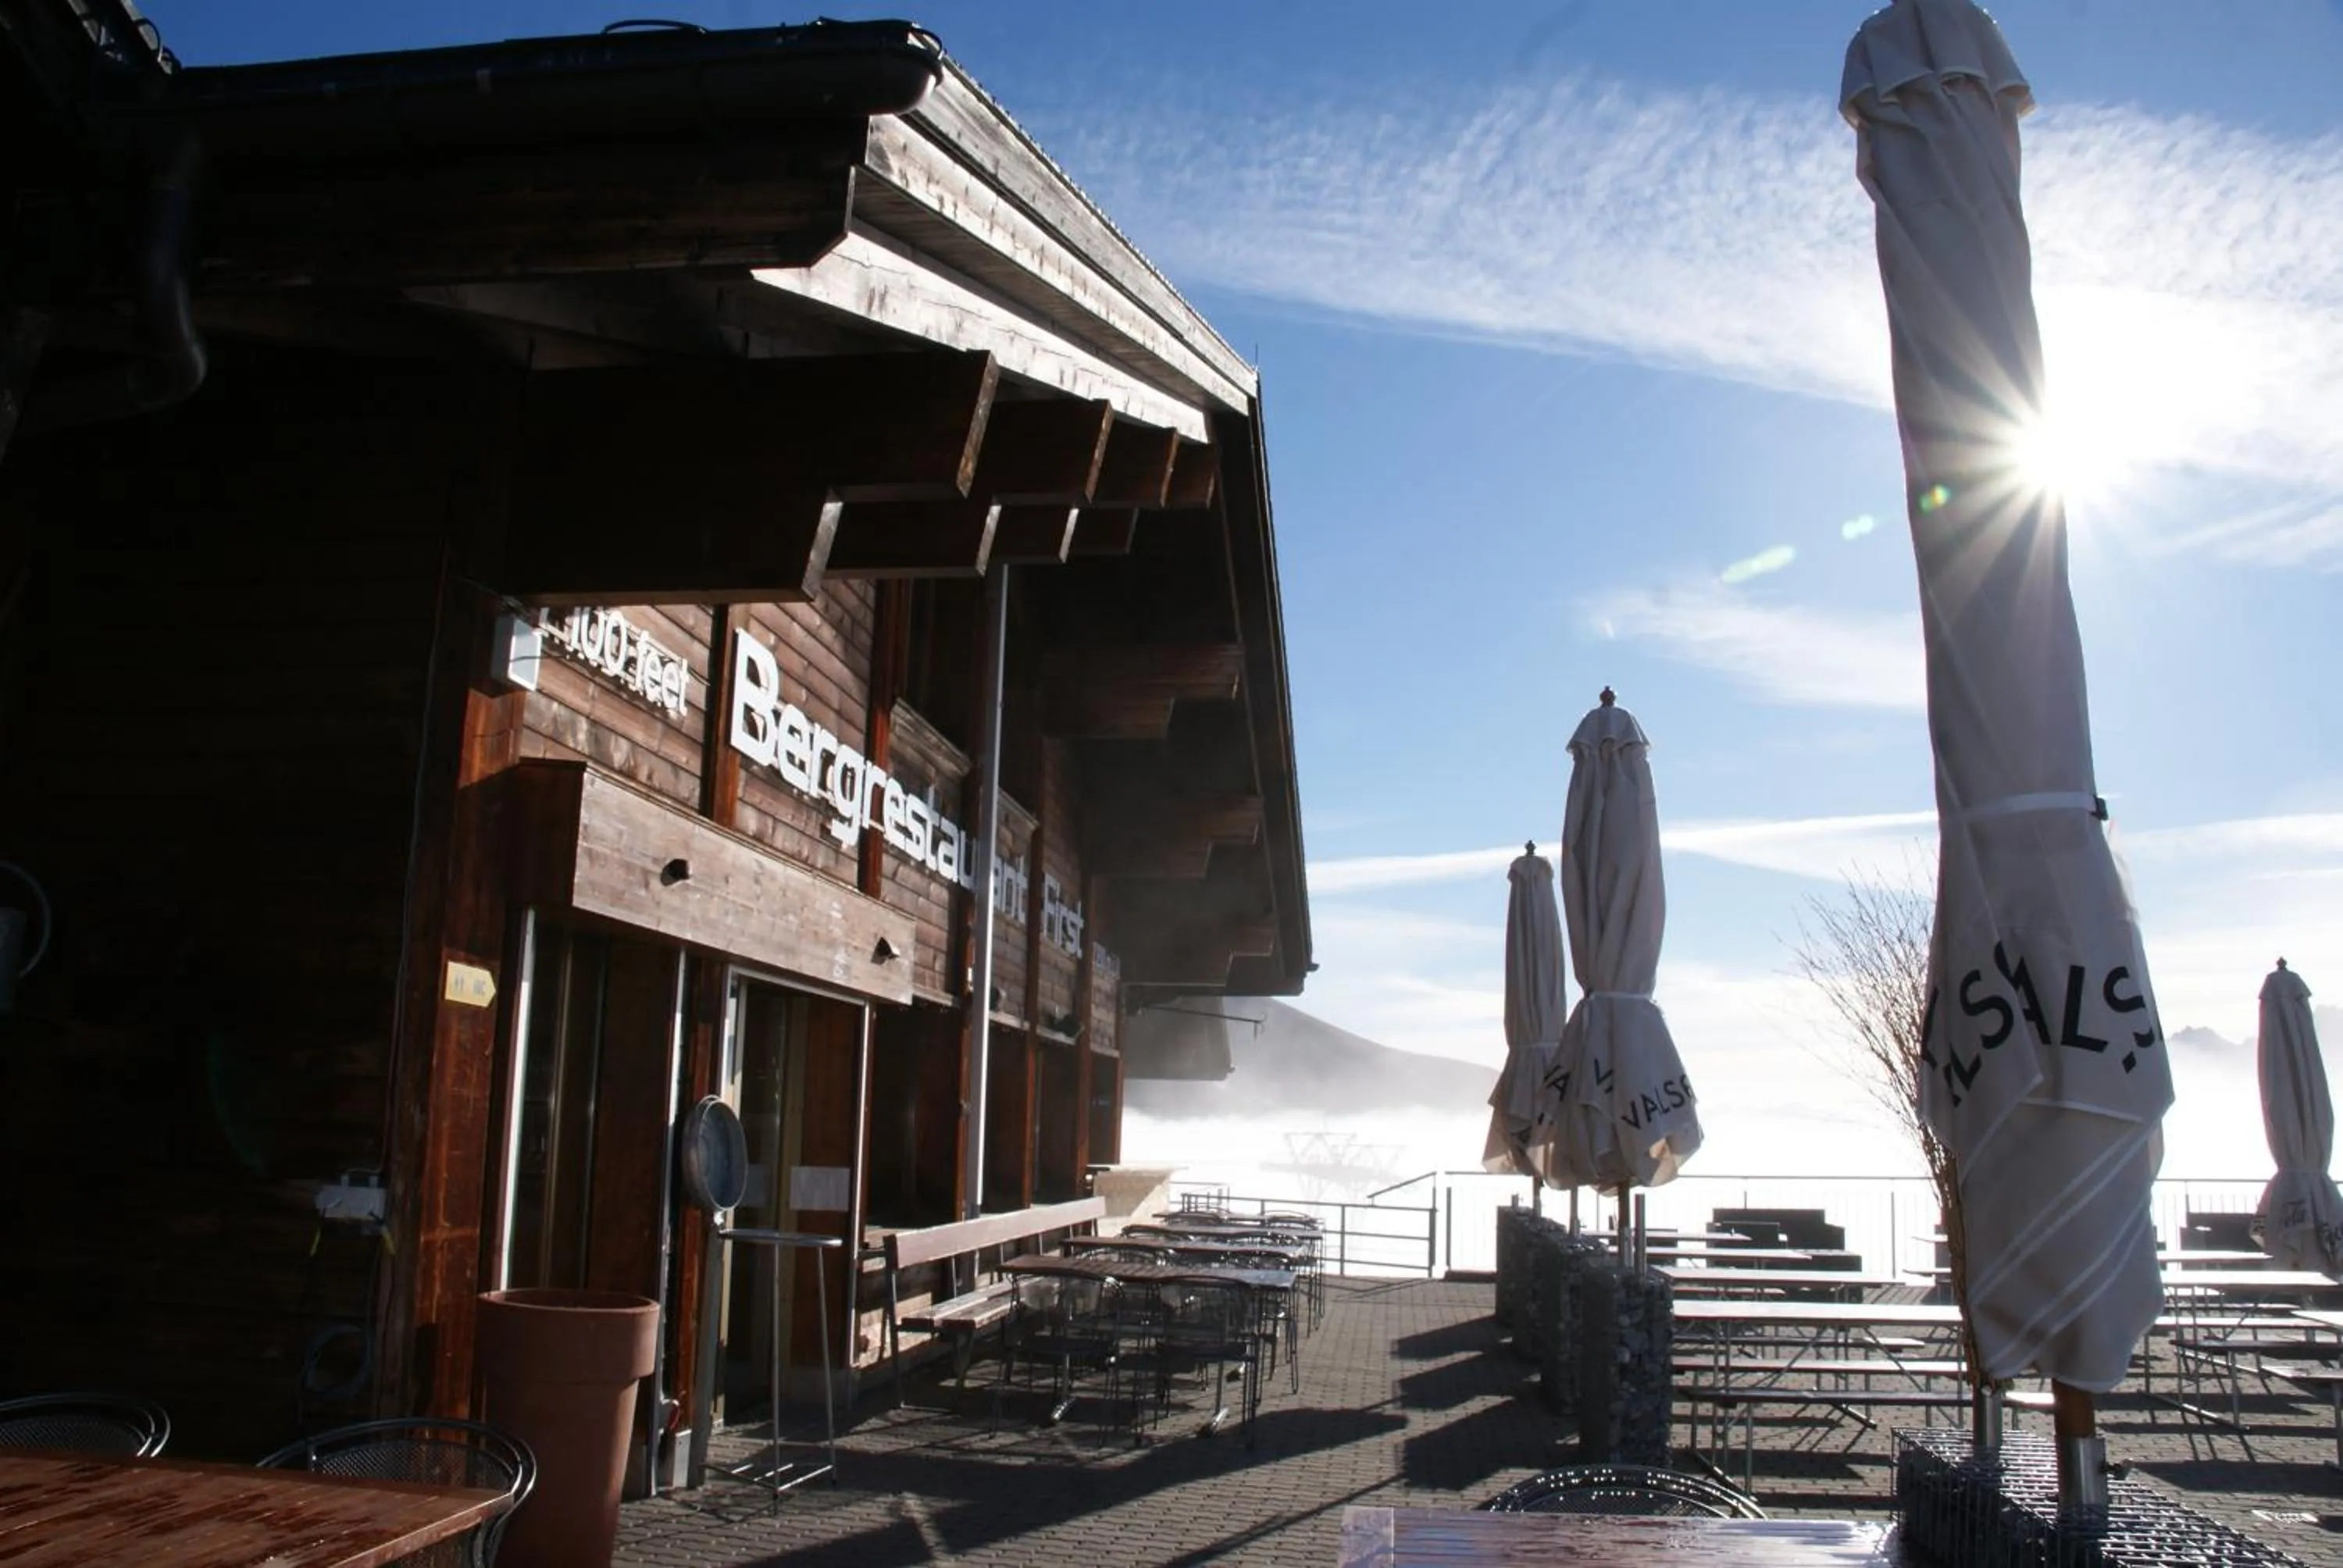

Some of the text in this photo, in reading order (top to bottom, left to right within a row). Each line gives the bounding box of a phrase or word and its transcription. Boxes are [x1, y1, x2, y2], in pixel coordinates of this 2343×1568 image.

[634, 629, 689, 717] feet
[729, 626, 1084, 960] Bergrestauant First
